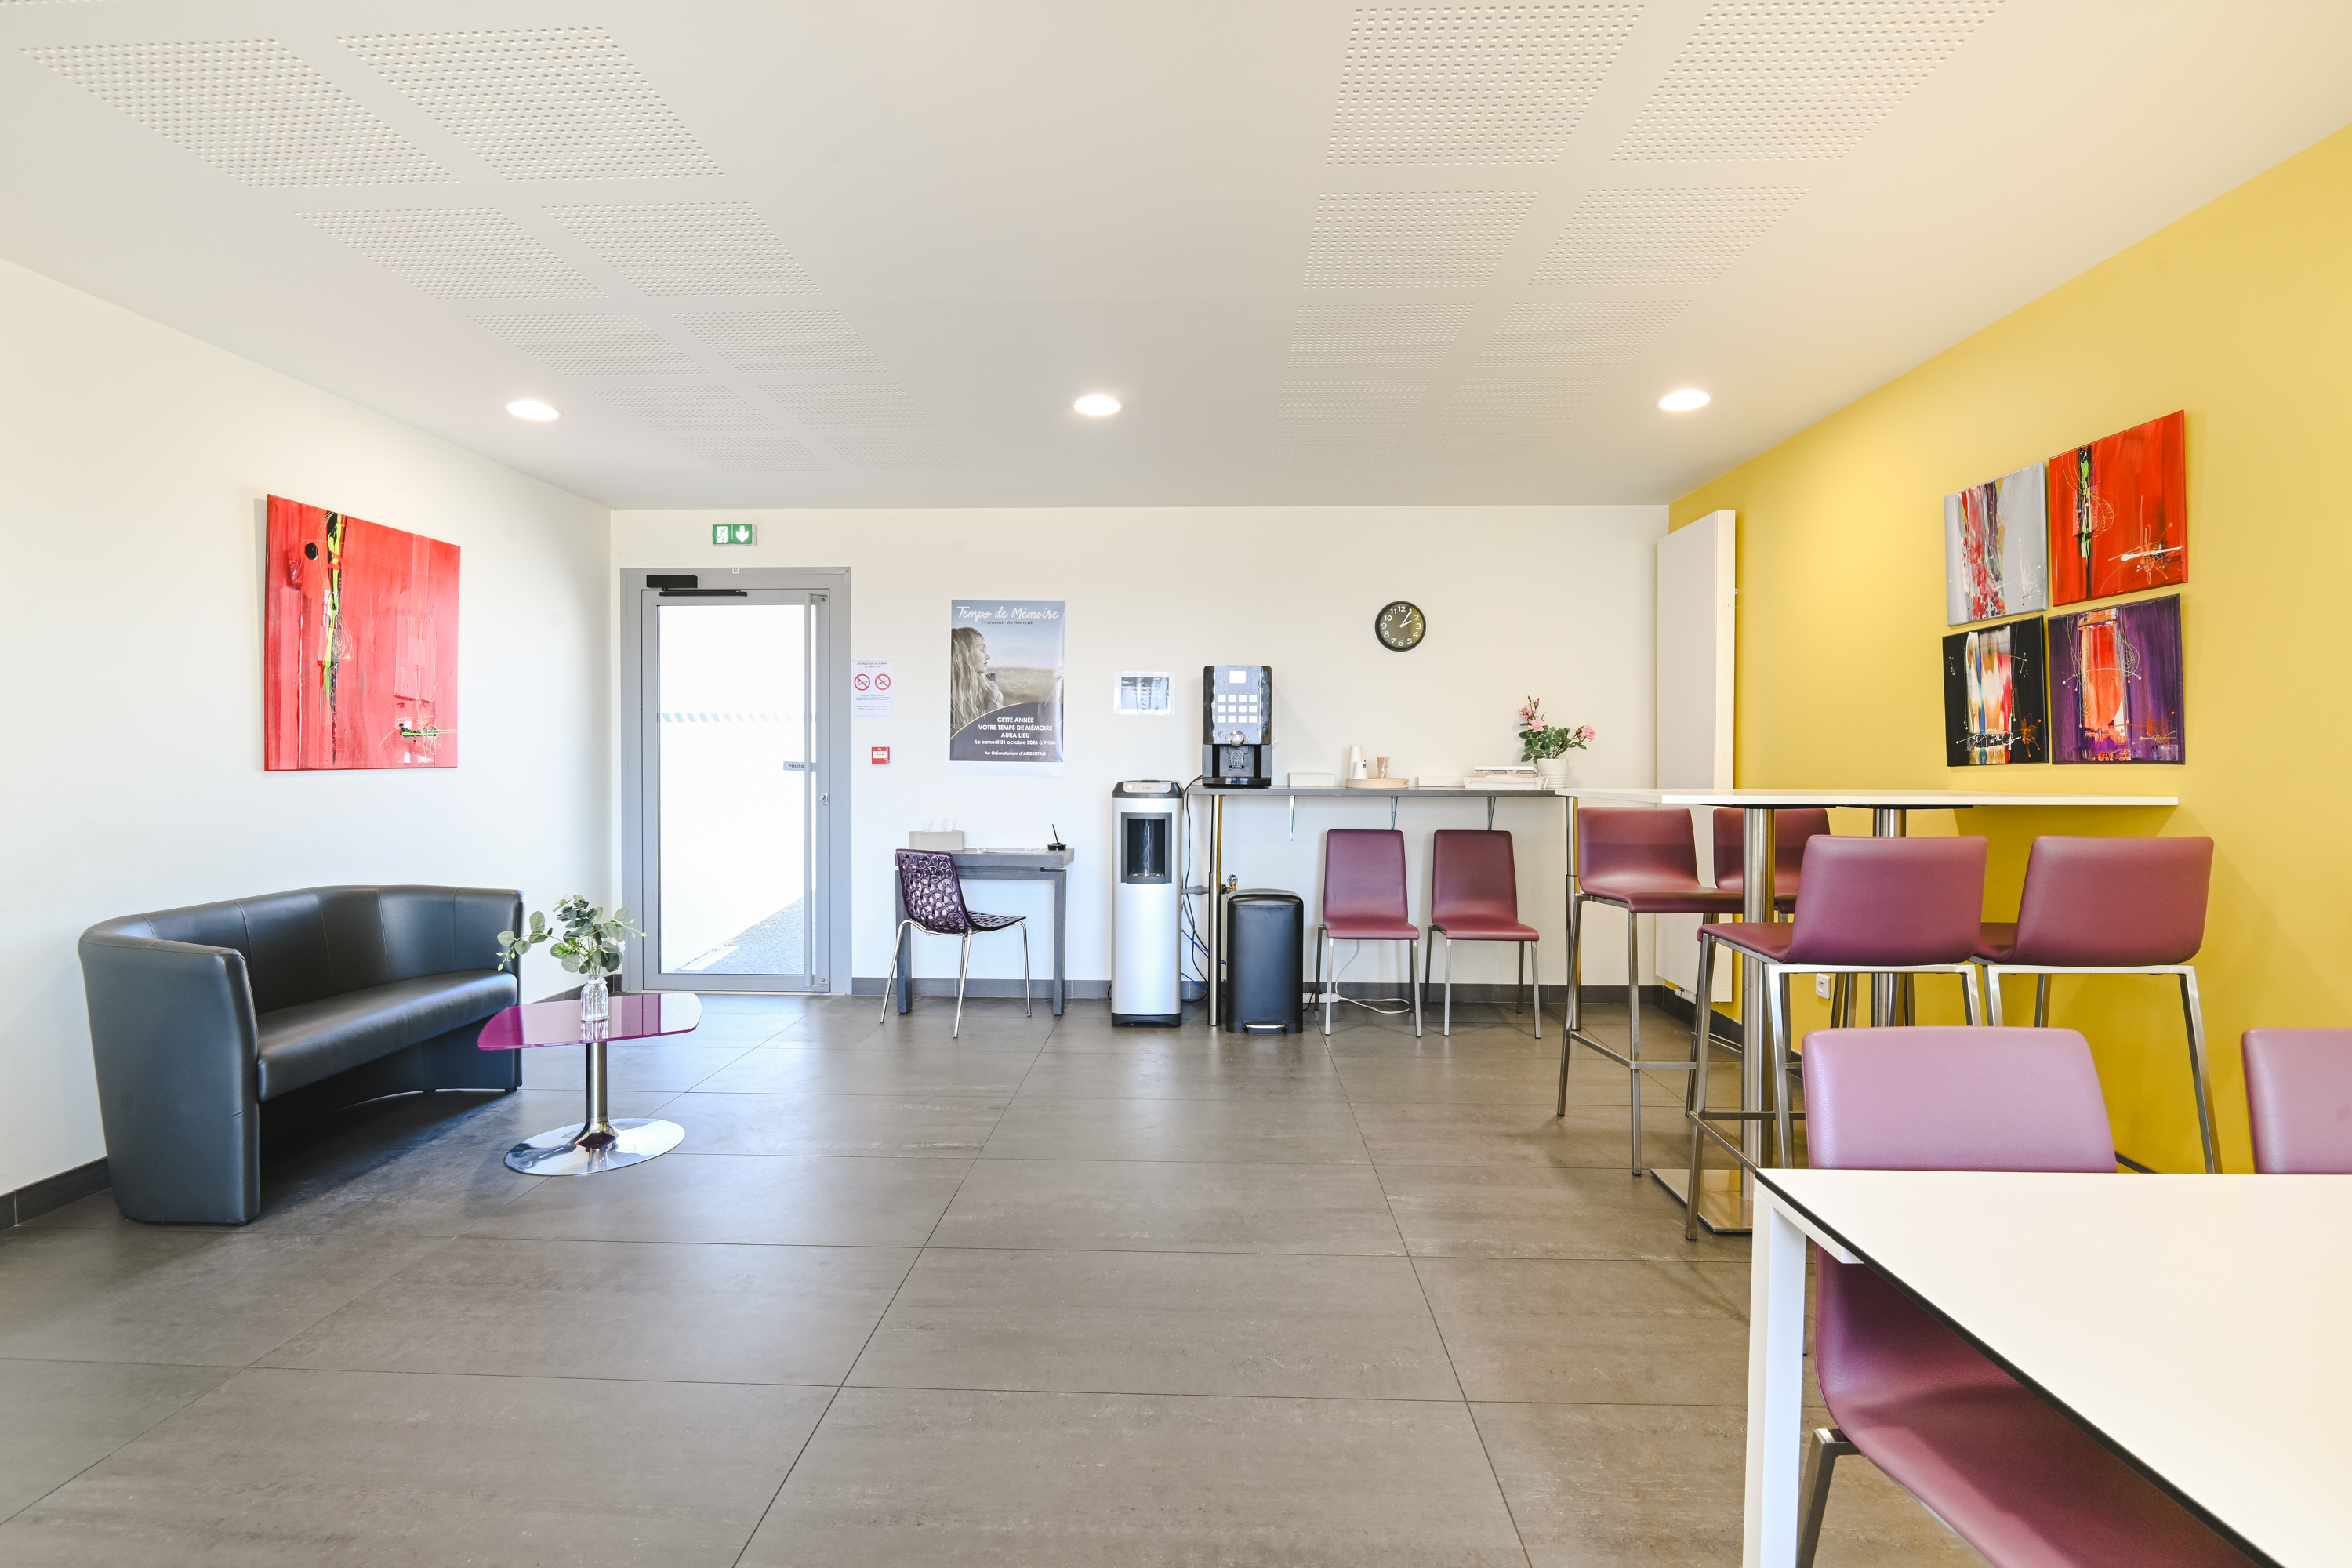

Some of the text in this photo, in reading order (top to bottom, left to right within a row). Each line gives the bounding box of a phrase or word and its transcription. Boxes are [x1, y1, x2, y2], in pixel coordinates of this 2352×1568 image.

[956, 606, 1059, 622] Temps de Mémoire
